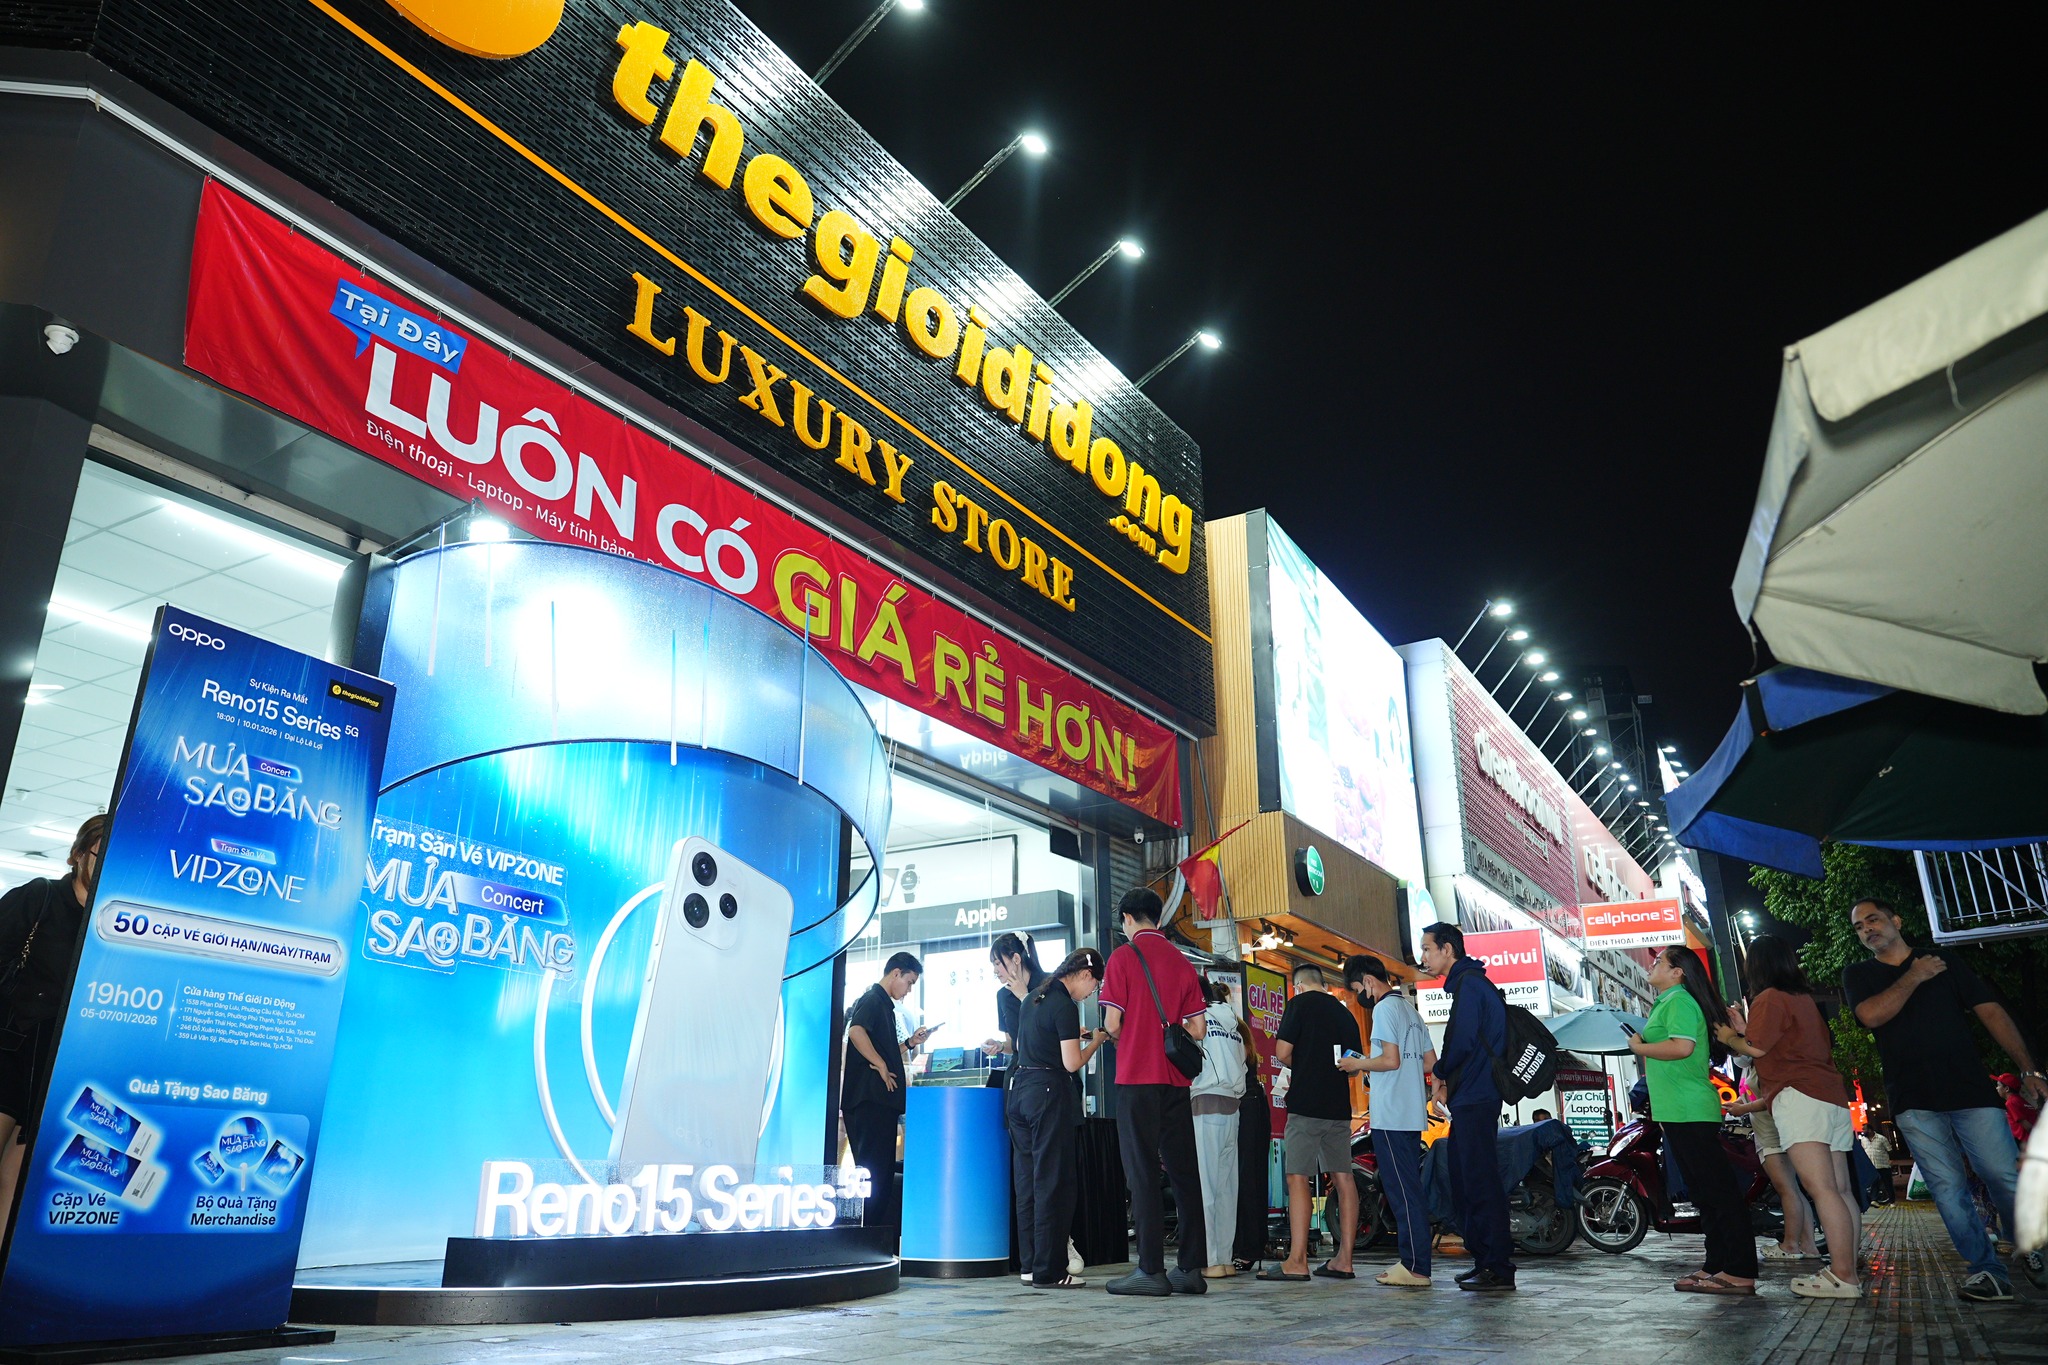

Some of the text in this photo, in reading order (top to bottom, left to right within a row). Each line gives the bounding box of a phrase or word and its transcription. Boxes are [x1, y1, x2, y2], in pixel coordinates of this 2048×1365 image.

[612, 20, 1193, 574] thegioididong
[340, 287, 460, 364] Tại Đây
[626, 272, 1076, 613] LUXURY STORE
[366, 420, 405, 453] Điện
[409, 442, 453, 478] thoại
[468, 471, 523, 512] Laptop
[536, 509, 567, 533] Máy
[569, 519, 597, 546] tính
[365, 342, 1137, 789] LUÔN CÓ GIÁ RẺ HƠN!
[168, 622, 226, 651] oppo
[249, 678, 309, 705] Sự Ra Mắt
[201, 678, 360, 740] Reno15 Series 5G
[216, 711, 235, 723] 18:00
[243, 720, 278, 736] 10.01.2026
[260, 761, 291, 778] Concert
[372, 818, 416, 849] Trạm
[460, 841, 483, 866] Vé
[486, 848, 564, 886] VIPZONE
[169, 848, 306, 903] VIPZONE
[481, 885, 545, 916] Concert
[954, 902, 1008, 928] Apple
[113, 910, 150, 937] 50
[152, 922, 180, 941] CẶP
[183, 926, 202, 942] VÉ
[202, 929, 228, 948] GIỚI
[86, 980, 164, 1011] 19h00
[183, 985, 296, 1010] Cửa hàng Thế Giới Di Động
[1249, 982, 1284, 1016] GIÁ RẺ
[80, 1007, 158, 1026] 05-07/01/2026
[1511, 1043, 1538, 1077] FASHION
[1520, 1051, 1546, 1084] INSIDER
[128, 1078, 268, 1105] Quà Tặng Sao Băng
[1571, 1104, 1606, 1115] Laptop
[51, 1192, 107, 1210] Cặp Vé
[195, 1194, 277, 1212] Bộ Quà Tặng
[475, 1161, 872, 1238] Reno15 Series 5G
[49, 1211, 120, 1225] VIPZONE
[190, 1212, 276, 1226] Merchandise
